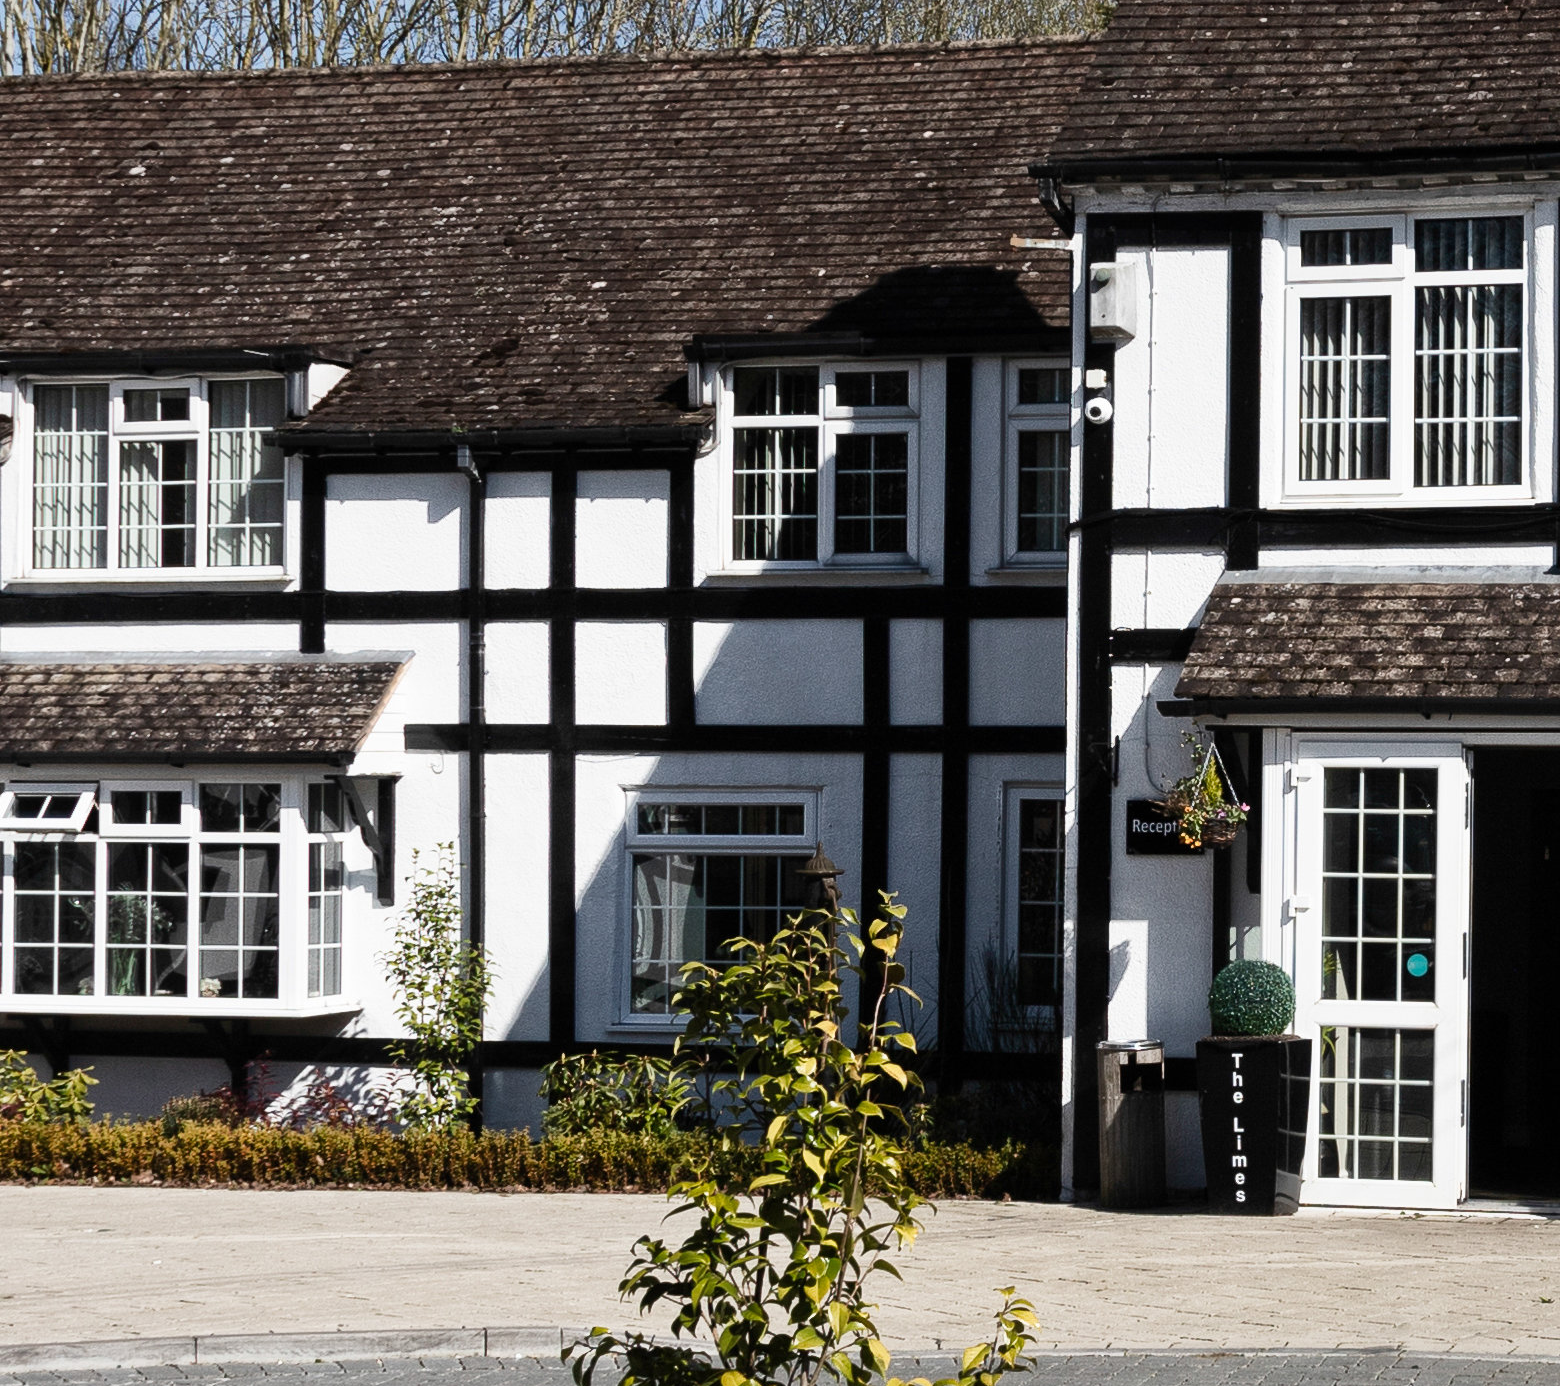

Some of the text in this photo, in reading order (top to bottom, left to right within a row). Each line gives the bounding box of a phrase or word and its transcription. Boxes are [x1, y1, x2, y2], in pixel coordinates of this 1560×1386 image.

[1132, 818, 1181, 837] Recept
[1231, 1053, 1248, 1203] The Limes
